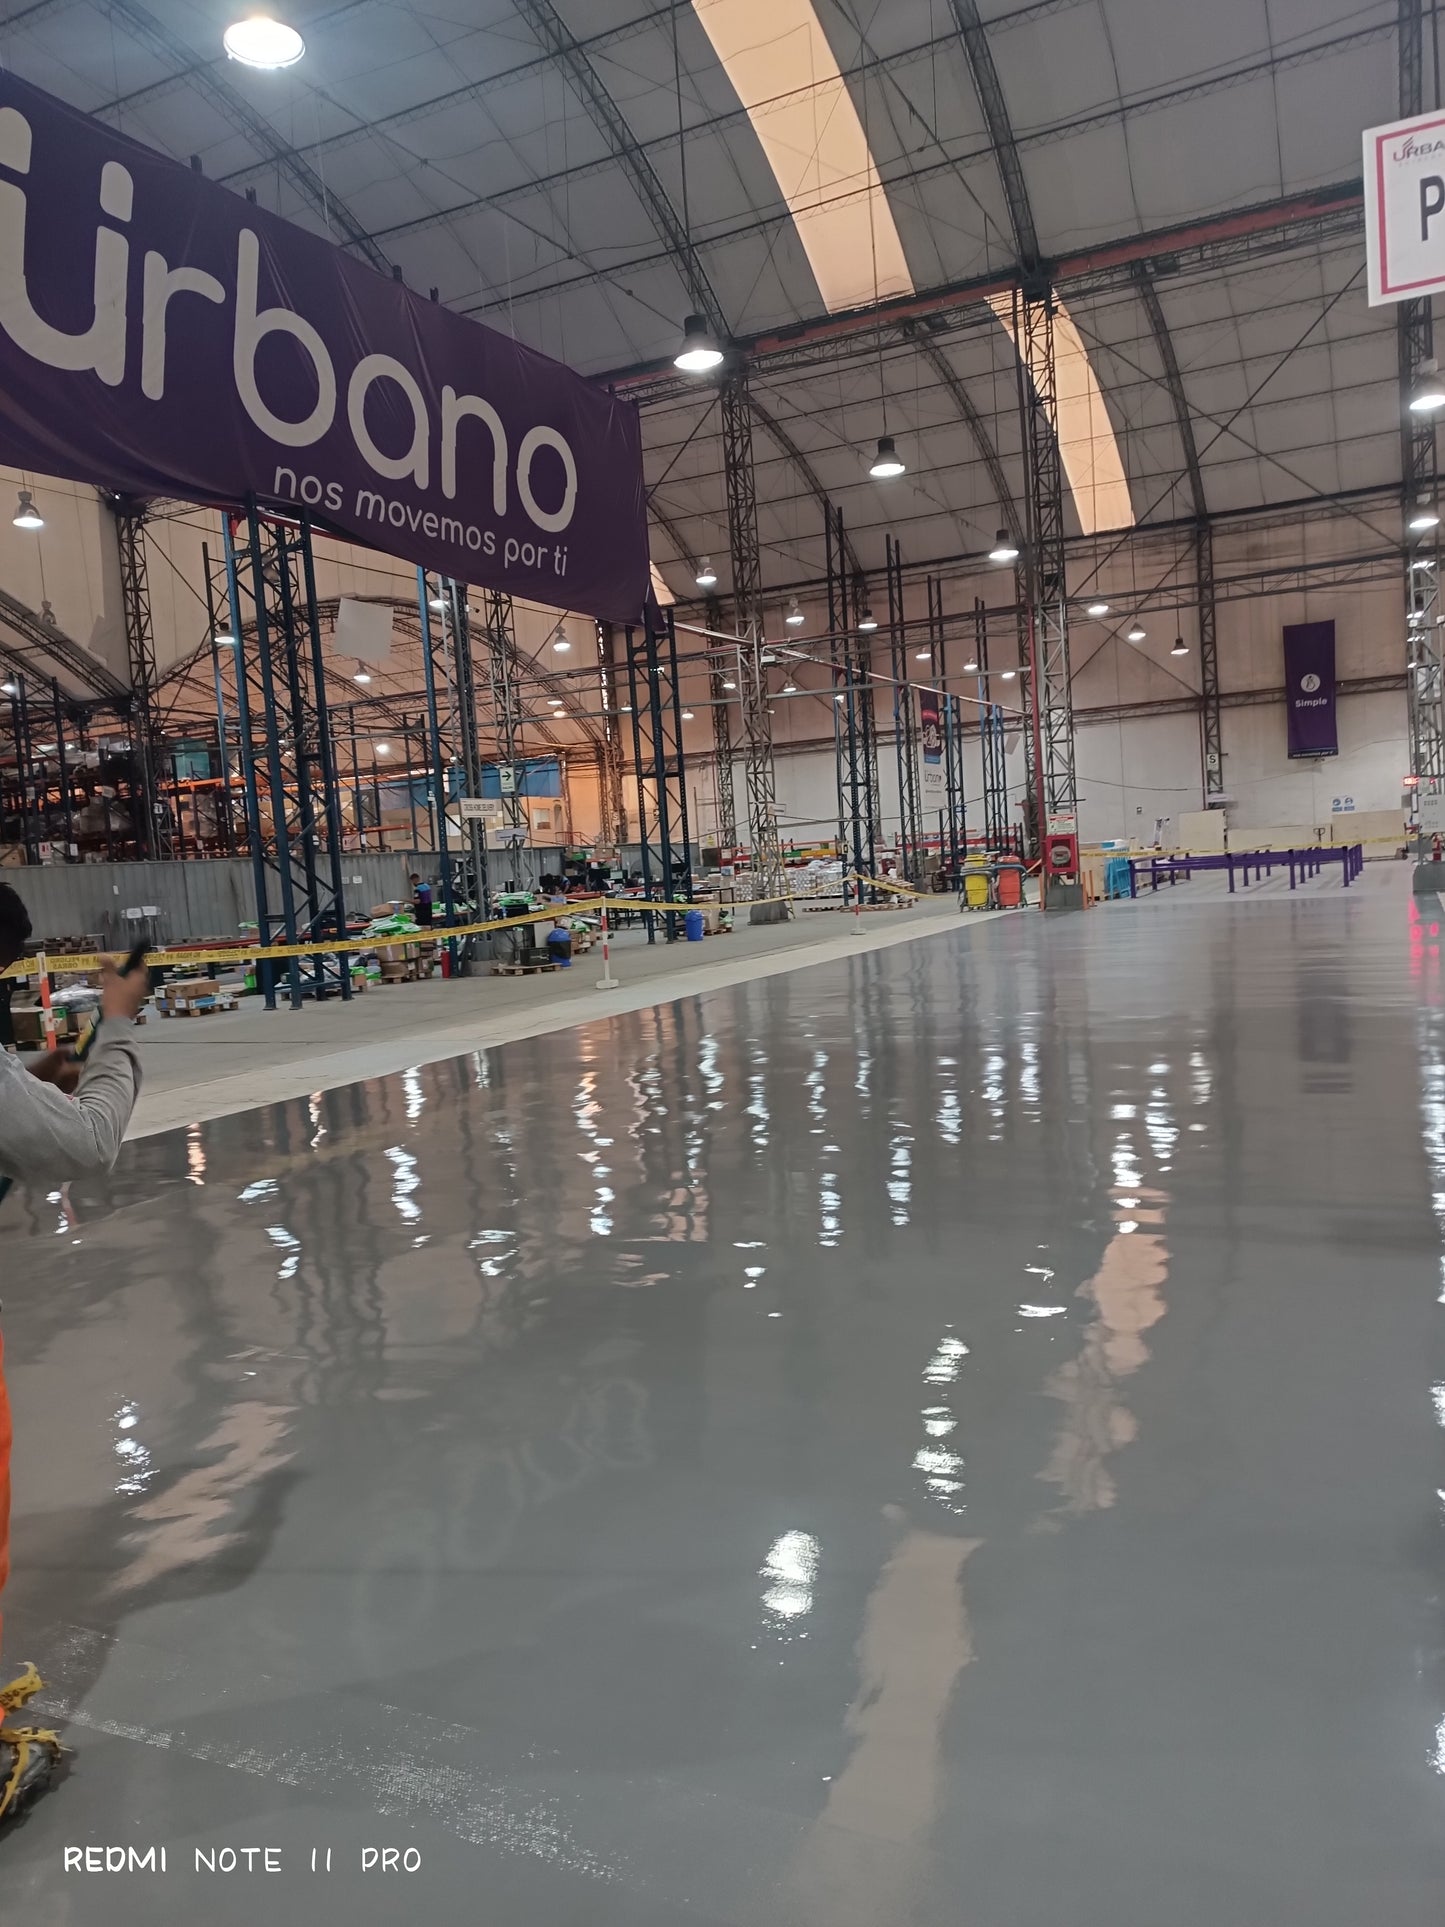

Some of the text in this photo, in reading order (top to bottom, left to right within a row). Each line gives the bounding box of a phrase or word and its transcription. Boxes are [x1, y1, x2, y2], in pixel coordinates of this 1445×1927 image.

[274, 466, 568, 577] nos movemos por ti
[1295, 697, 1328, 708] Simple
[1209, 754, 1216, 764] S
